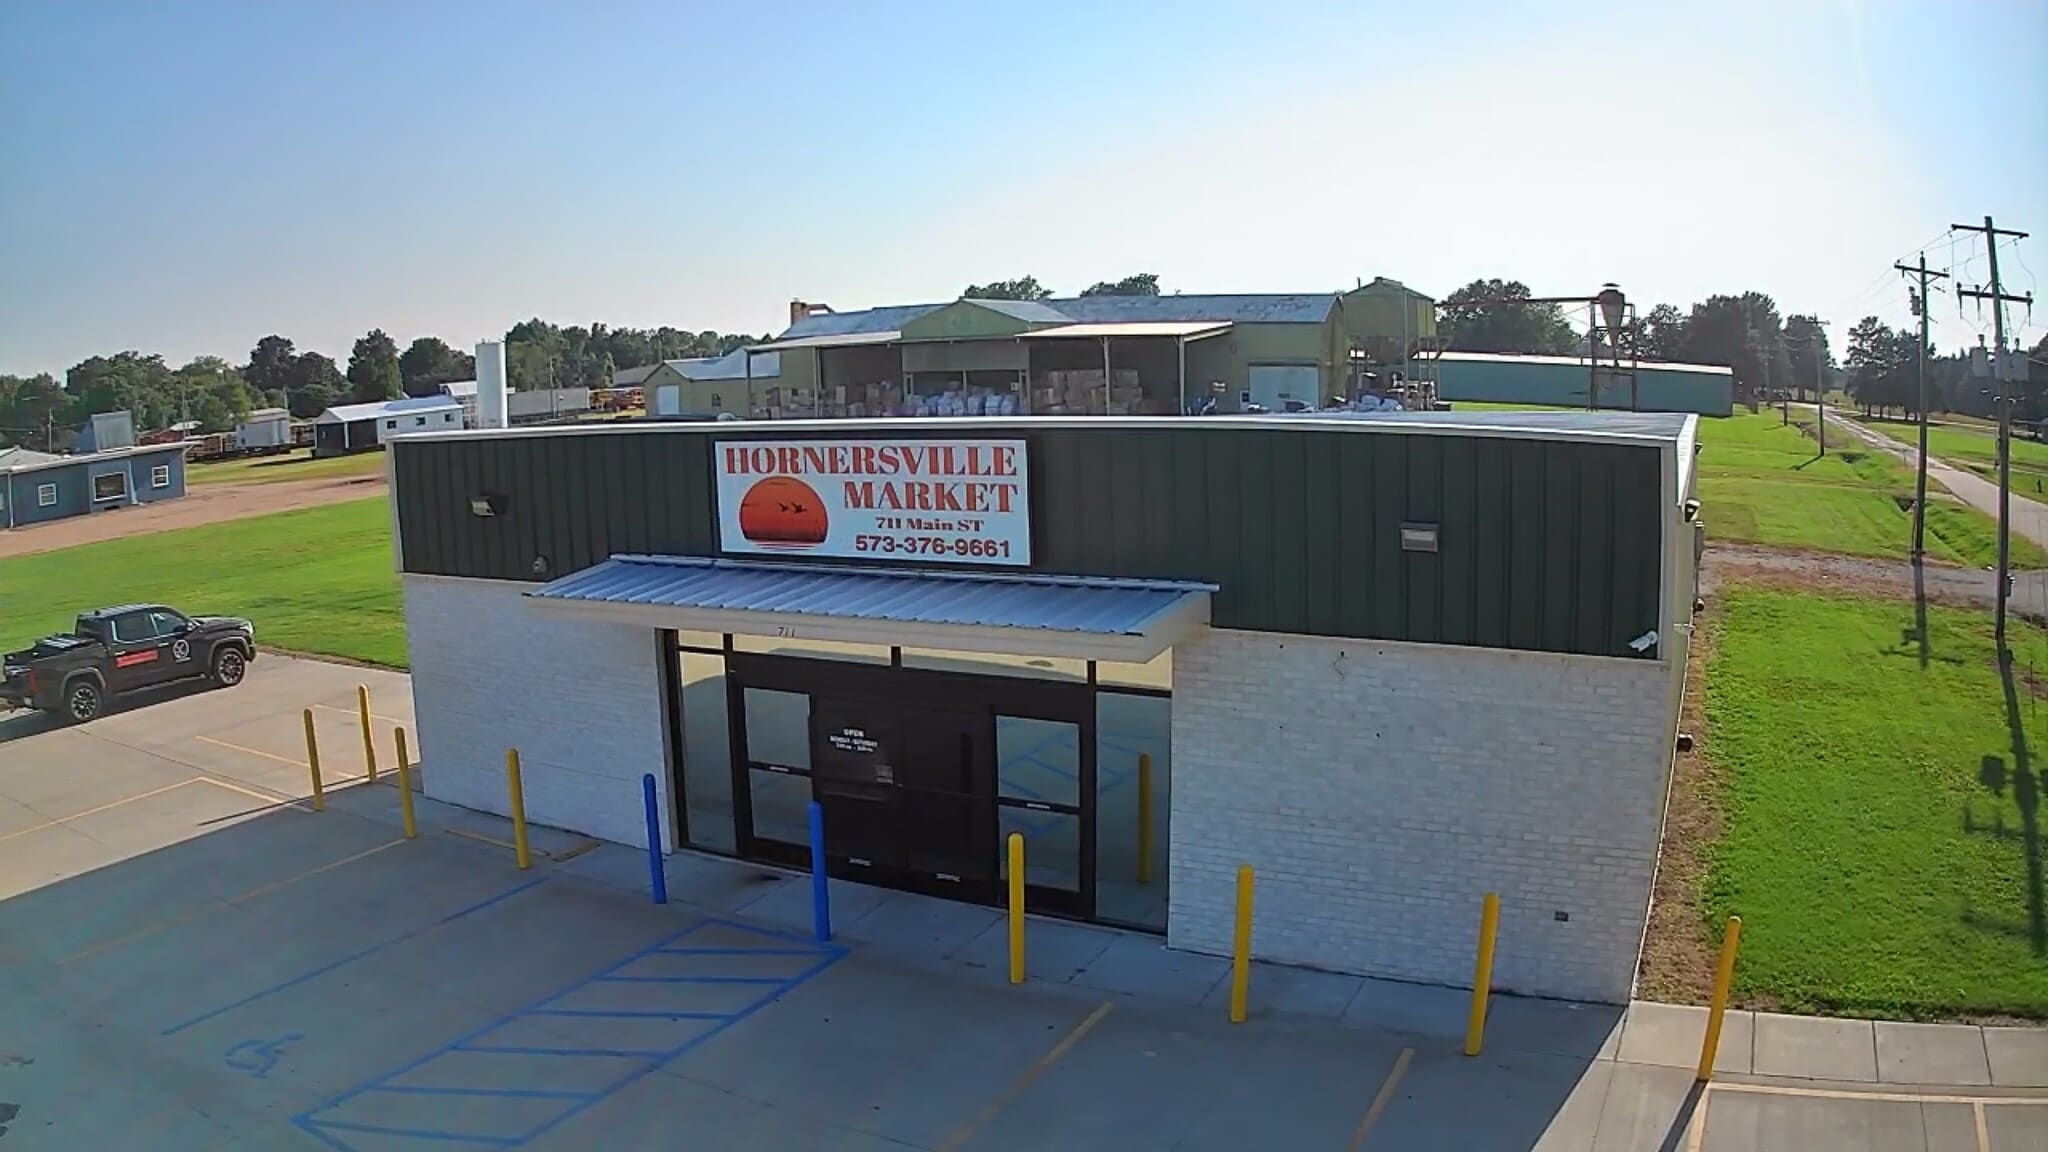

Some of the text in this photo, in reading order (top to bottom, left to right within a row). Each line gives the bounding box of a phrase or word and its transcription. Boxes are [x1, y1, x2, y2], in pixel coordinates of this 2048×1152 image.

[725, 446, 1017, 476] HORNERSVILLE
[844, 481, 1018, 513] MARKET
[875, 517, 984, 533] 711 Main ST
[855, 535, 1010, 558] 573-376-9661
[778, 627, 796, 638] 711
